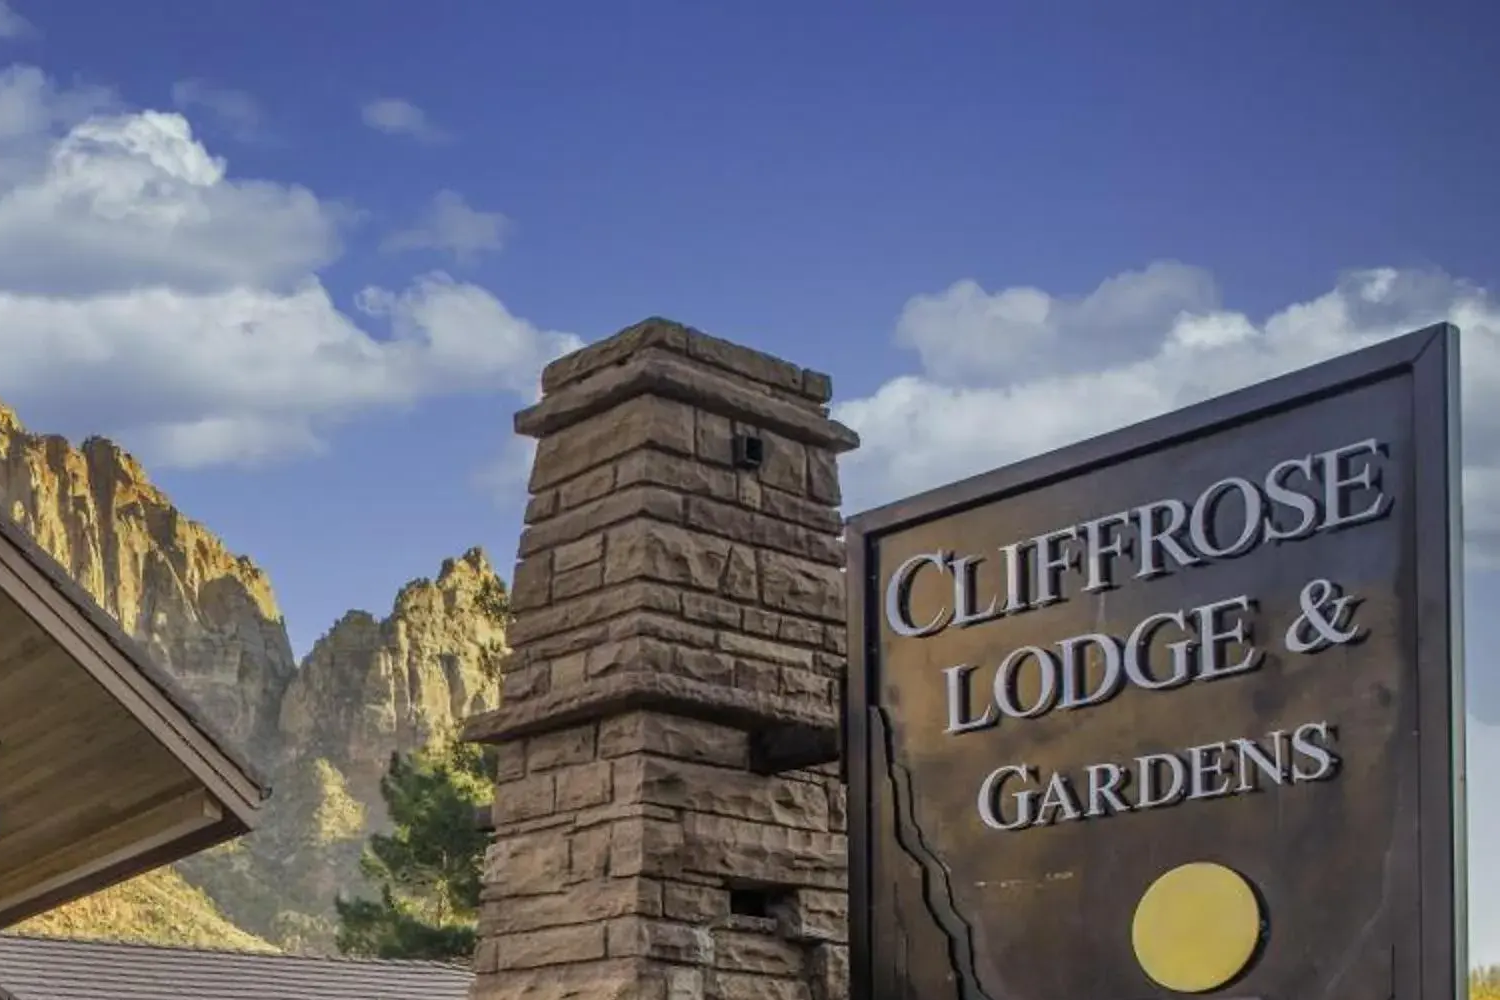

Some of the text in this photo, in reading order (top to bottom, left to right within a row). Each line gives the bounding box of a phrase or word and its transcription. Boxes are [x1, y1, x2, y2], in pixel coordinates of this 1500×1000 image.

[886, 438, 1390, 638] CLIFFROSE
[942, 578, 1362, 735] LODGE &
[977, 721, 1336, 831] GARDENS
